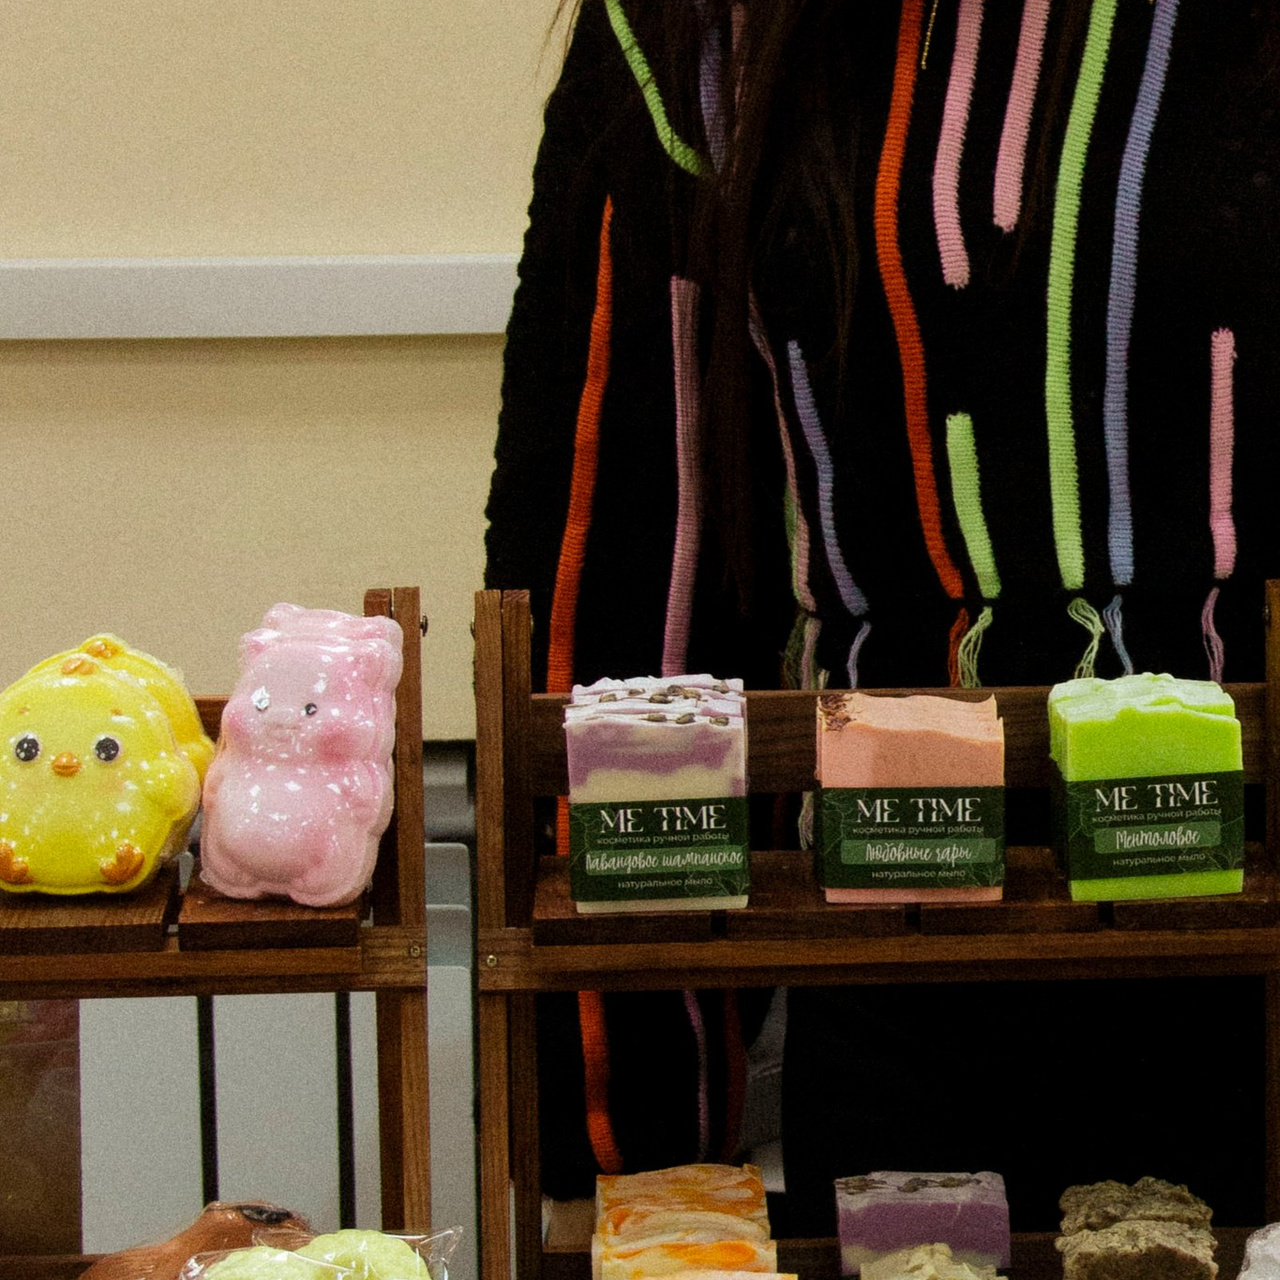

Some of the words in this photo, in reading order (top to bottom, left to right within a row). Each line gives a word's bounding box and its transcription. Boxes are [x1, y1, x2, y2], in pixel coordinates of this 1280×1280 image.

[1094, 785, 1138, 812] ME
[1147, 780, 1218, 808] TIME
[600, 808, 644, 833] ME
[653, 804, 726, 831] TIME
[856, 798, 900, 823] ME
[910, 797, 981, 822] TIME
[1092, 813, 1145, 823] косметика
[1147, 810, 1184, 822] ручной
[1185, 807, 1222, 818] работы
[597, 836, 651, 845] косметика
[653, 833, 690, 845] ручной
[693, 831, 730, 842] работы
[852, 826, 906, 835] косметика
[908, 825, 945, 836] ручной
[947, 824, 984, 834] работы
[1116, 826, 1200, 850] Ментоловое
[585, 852, 660, 874] Лавандовое
[662, 850, 744, 868] шампанское
[865, 842, 932, 862] Любовные
[936, 843, 972, 867] чары
[1113, 855, 1176, 867] натуральное
[618, 878, 683, 890] натуральное
[685, 877, 713, 887] мыло
[871, 870, 936, 881] натуральное
[938, 869, 966, 878] мыло
